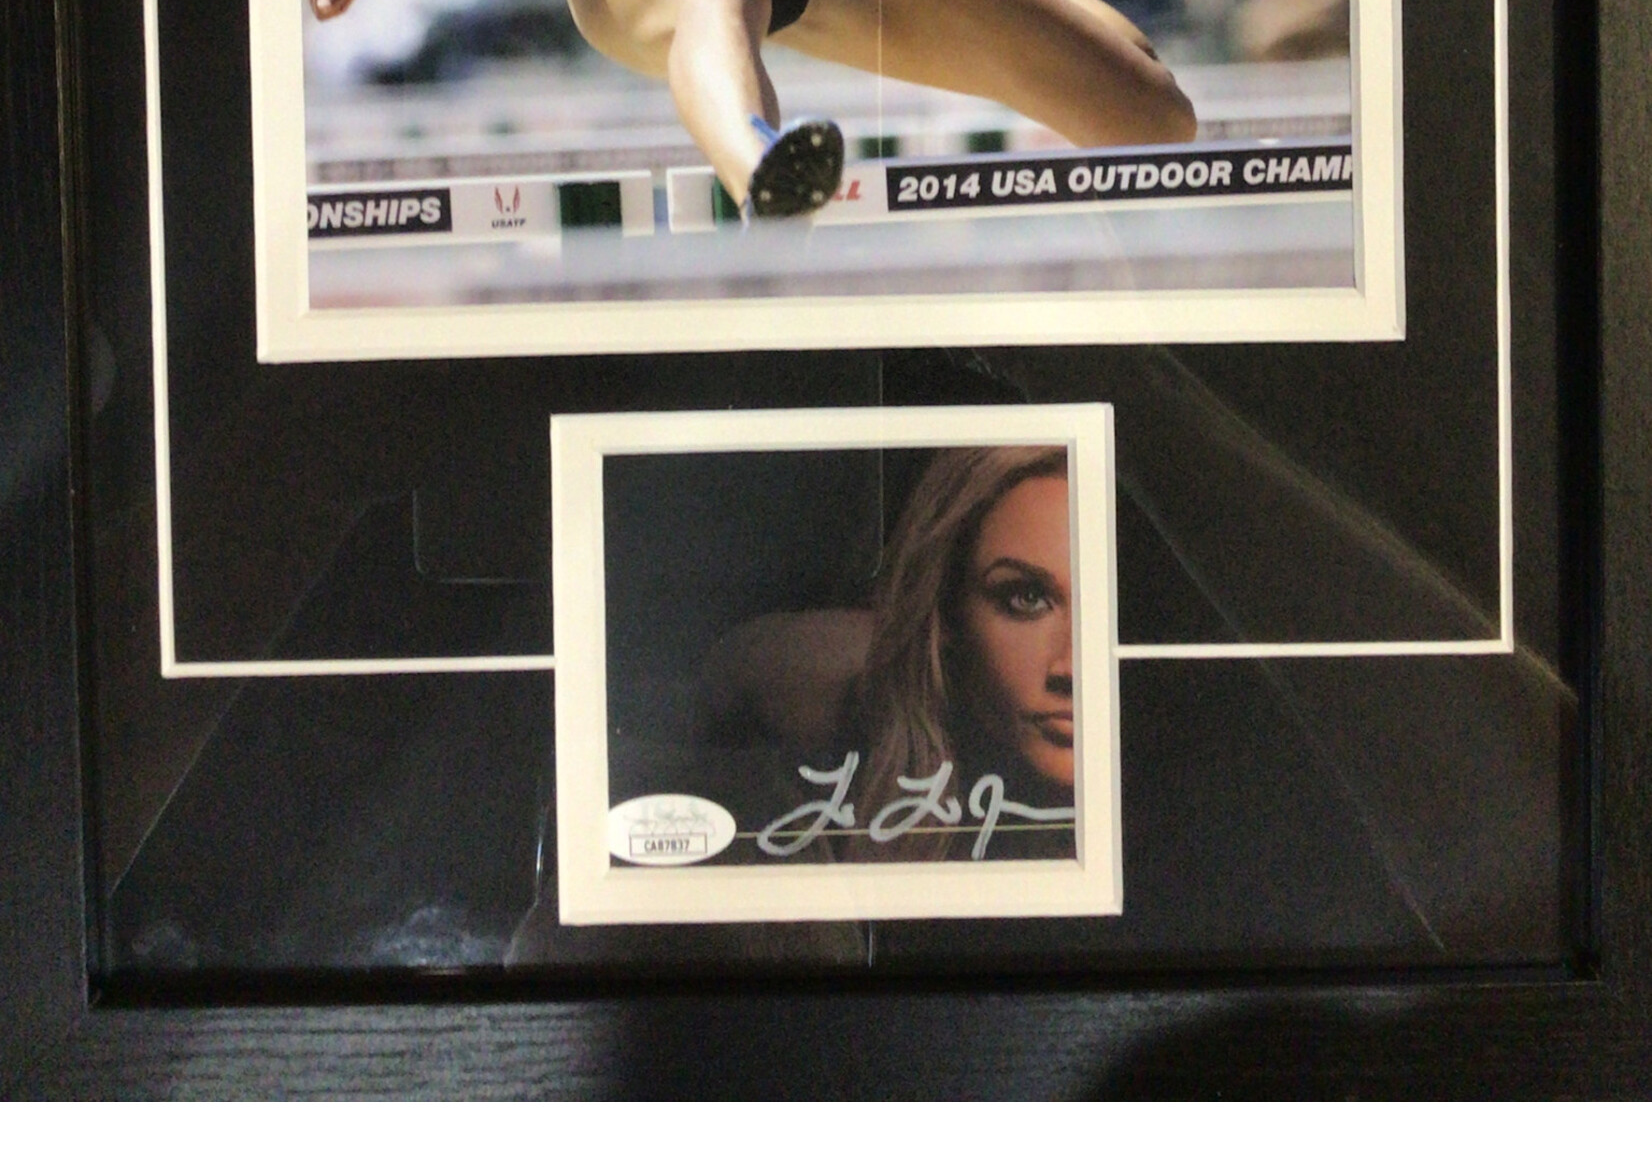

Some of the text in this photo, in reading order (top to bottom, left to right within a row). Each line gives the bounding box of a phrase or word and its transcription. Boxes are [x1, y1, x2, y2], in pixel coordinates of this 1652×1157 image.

[897, 173, 980, 203] 2014
[991, 169, 1057, 196] USA
[1068, 160, 1233, 193] OUTDOOR
